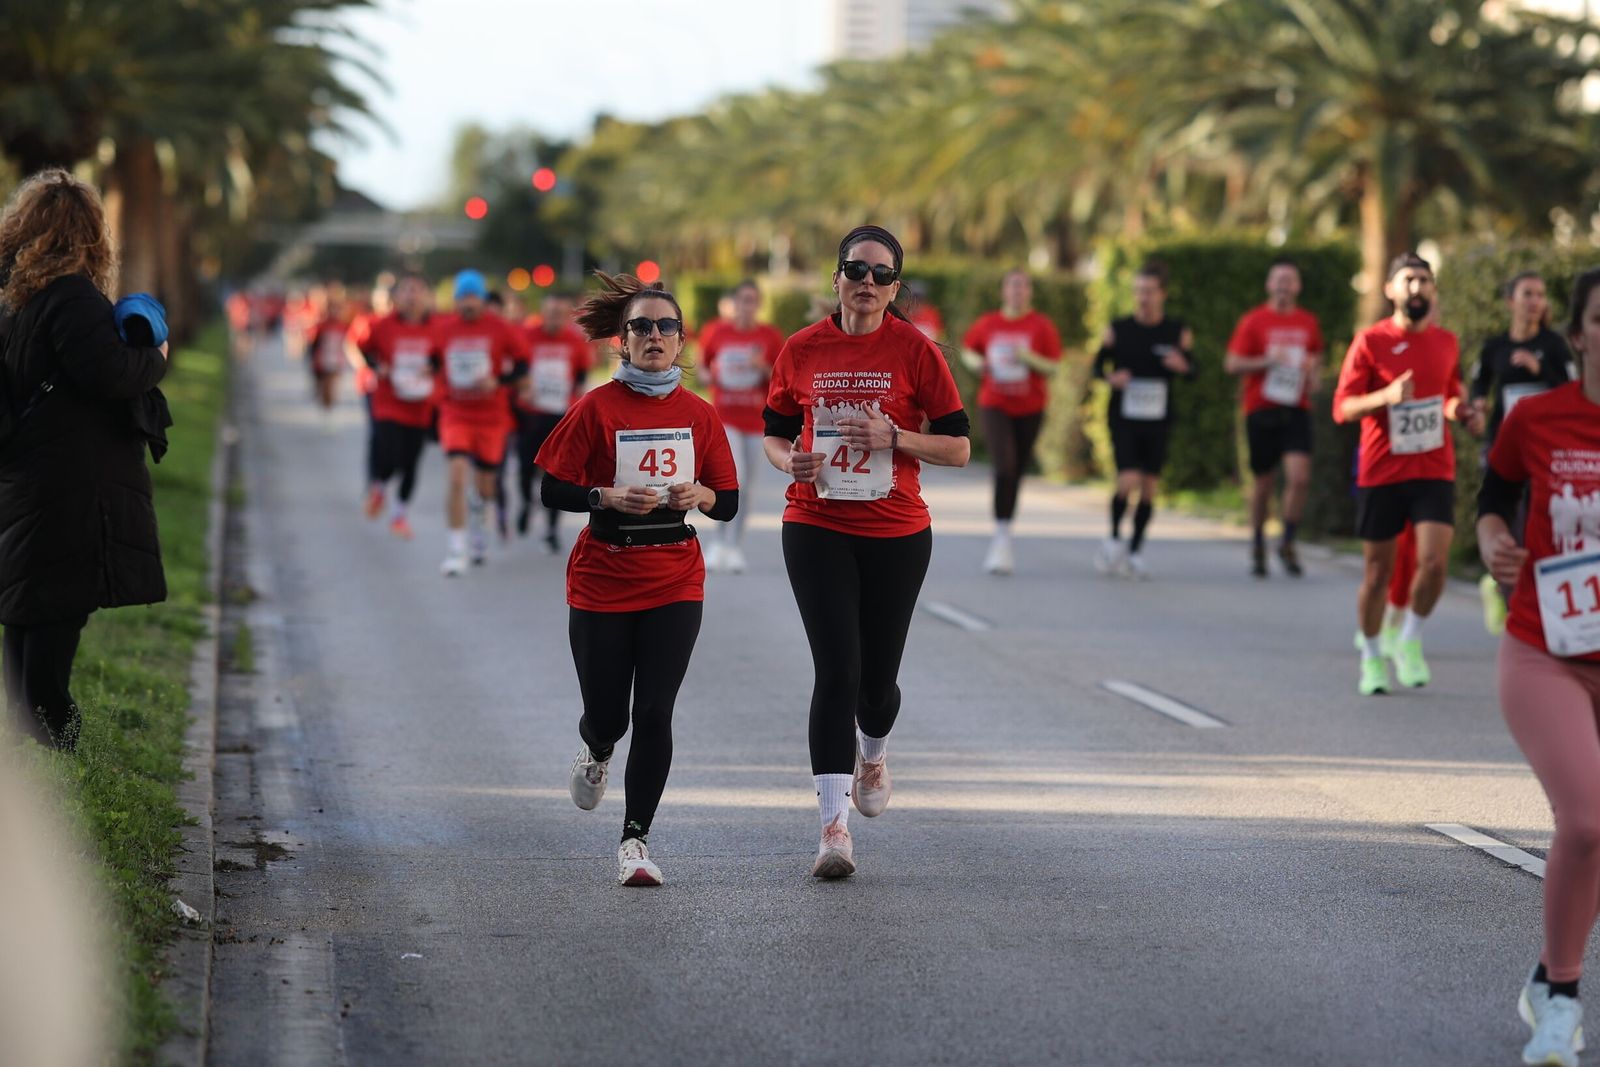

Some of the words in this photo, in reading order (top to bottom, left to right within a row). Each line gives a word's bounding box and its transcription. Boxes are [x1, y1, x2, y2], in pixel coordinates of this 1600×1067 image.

[812, 380, 849, 388] CIUDAD
[852, 378, 891, 389] JARDÍN
[638, 448, 678, 477] 43
[830, 444, 871, 474] 42
